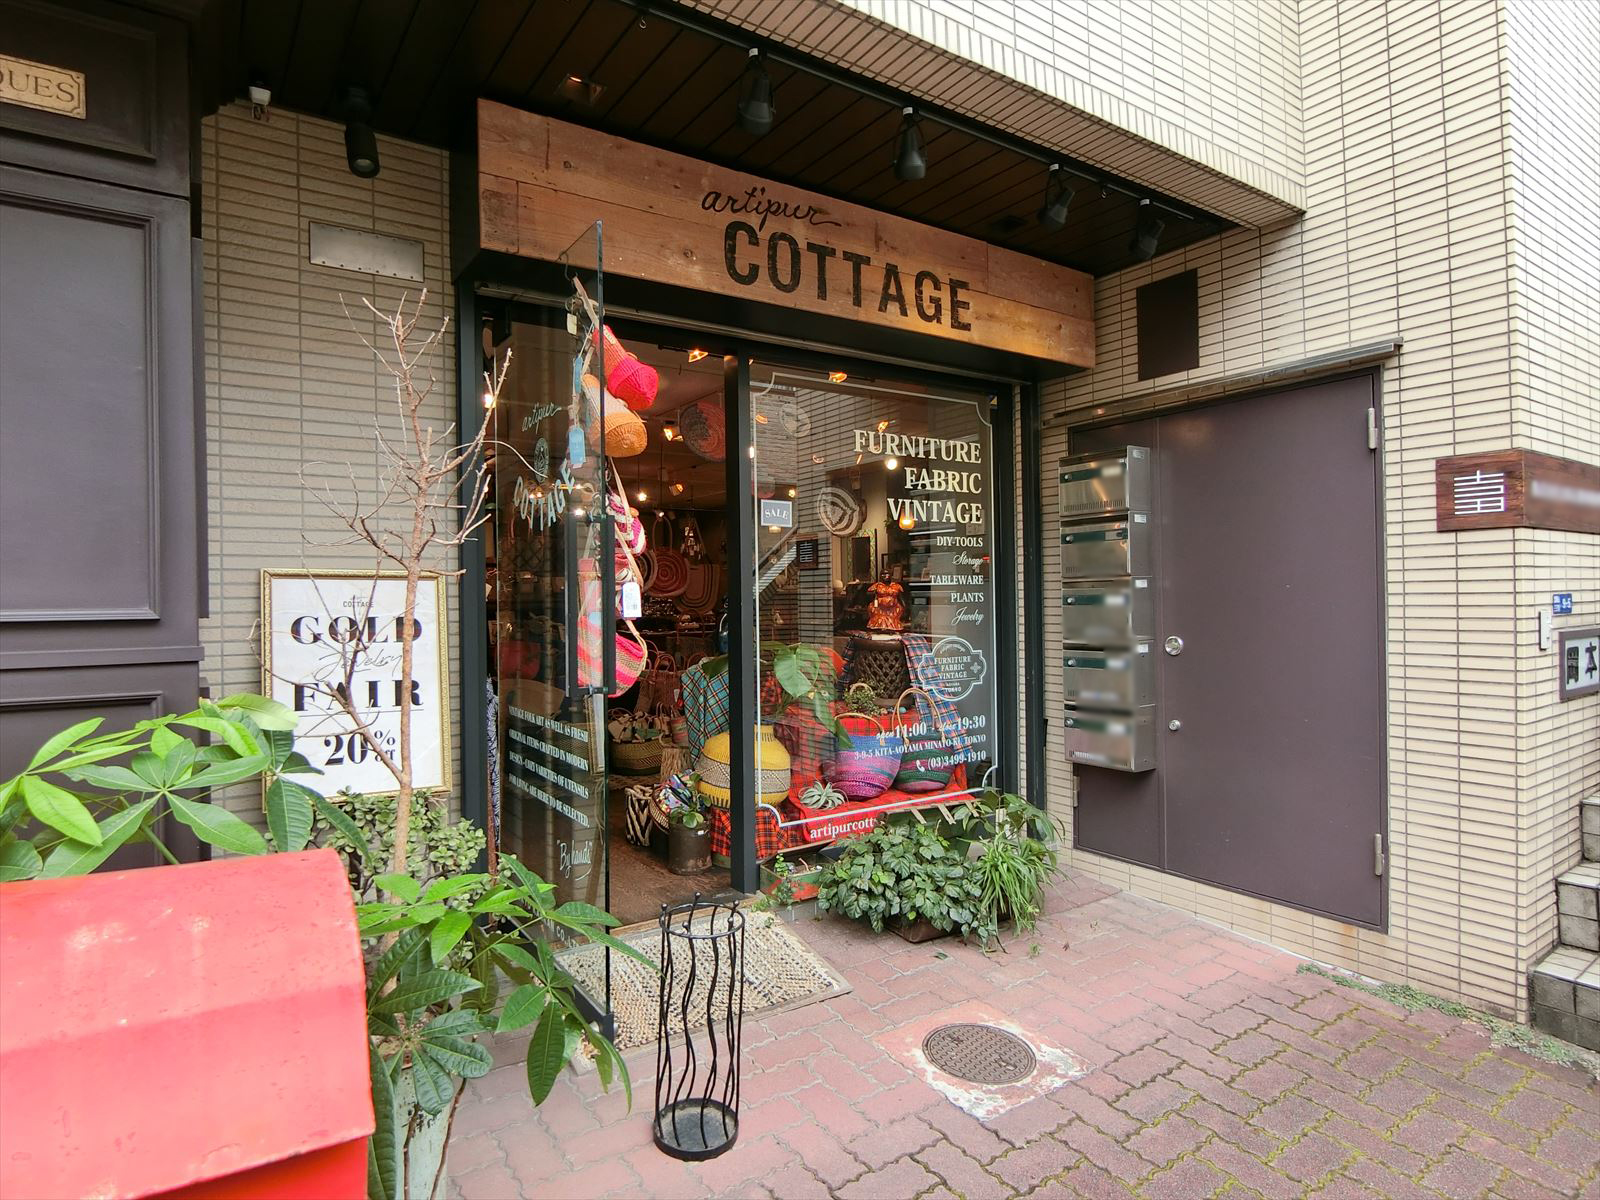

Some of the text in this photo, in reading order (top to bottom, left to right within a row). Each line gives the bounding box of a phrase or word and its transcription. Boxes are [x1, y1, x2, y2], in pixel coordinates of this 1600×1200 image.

[701, 187, 842, 232] artipur
[724, 221, 971, 332] COTTAGE
[853, 429, 982, 463] FURNITURE
[904, 467, 982, 494] FABRIC
[513, 458, 575, 532] COTTAGE
[764, 509, 789, 519] SALE
[887, 498, 983, 524] VINTAGE
[936, 536, 983, 547] DIY-TOOLS
[952, 551, 983, 569] Storage
[930, 575, 984, 585] TABLEWARE
[951, 592, 984, 602] PLANTS
[951, 606, 984, 625] Jewelry
[291, 615, 423, 645] GOLD
[934, 655, 971, 664] FURNITURE
[941, 663, 965, 672] FABRIC
[938, 671, 967, 680] VINTAGE
[292, 679, 424, 712] FAIR
[571, 726, 589, 742] FRESH
[895, 722, 927, 738] 11:00
[957, 714, 986, 731] 19:30
[964, 734, 986, 744] TOKYO
[566, 751, 589, 772] MODERN
[928, 751, 986, 770] (03)3499-1910
[564, 777, 589, 800] UTENSILS
